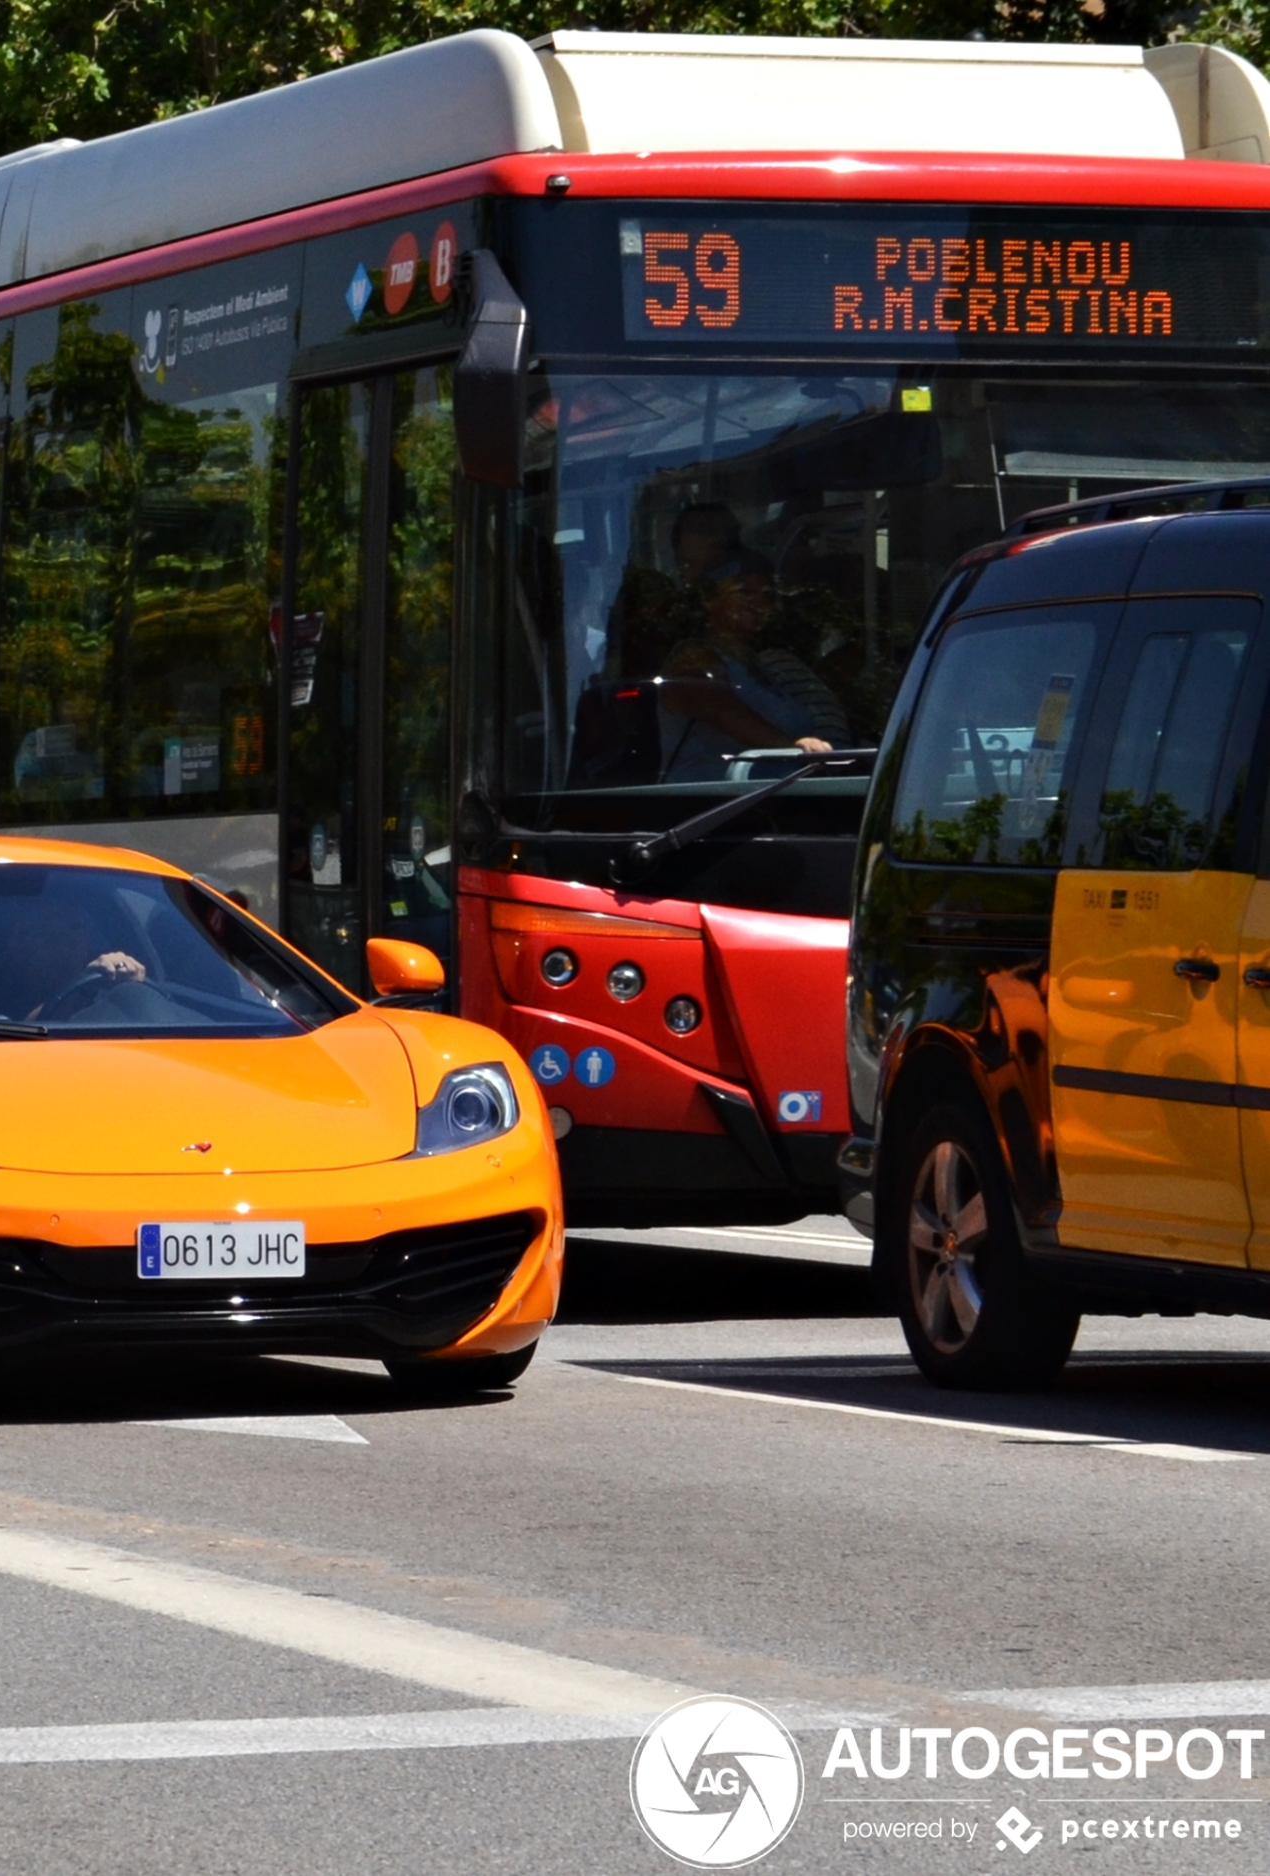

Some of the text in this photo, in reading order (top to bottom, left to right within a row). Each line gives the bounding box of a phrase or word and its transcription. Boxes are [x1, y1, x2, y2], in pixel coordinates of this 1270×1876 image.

[390, 260, 415, 286] TMB
[436, 239, 451, 286] B
[644, 232, 740, 327] 59
[876, 237, 1131, 286] POBLENOU
[183, 305, 225, 327] Respectem
[255, 284, 289, 308] Ambient
[834, 285, 1172, 336] R.M.CRISTINA
[233, 716, 264, 775] 59
[1083, 889, 1107, 909] TAXI
[146, 1256, 155, 1268] E
[163, 1233, 299, 1266] 0613 JHC
